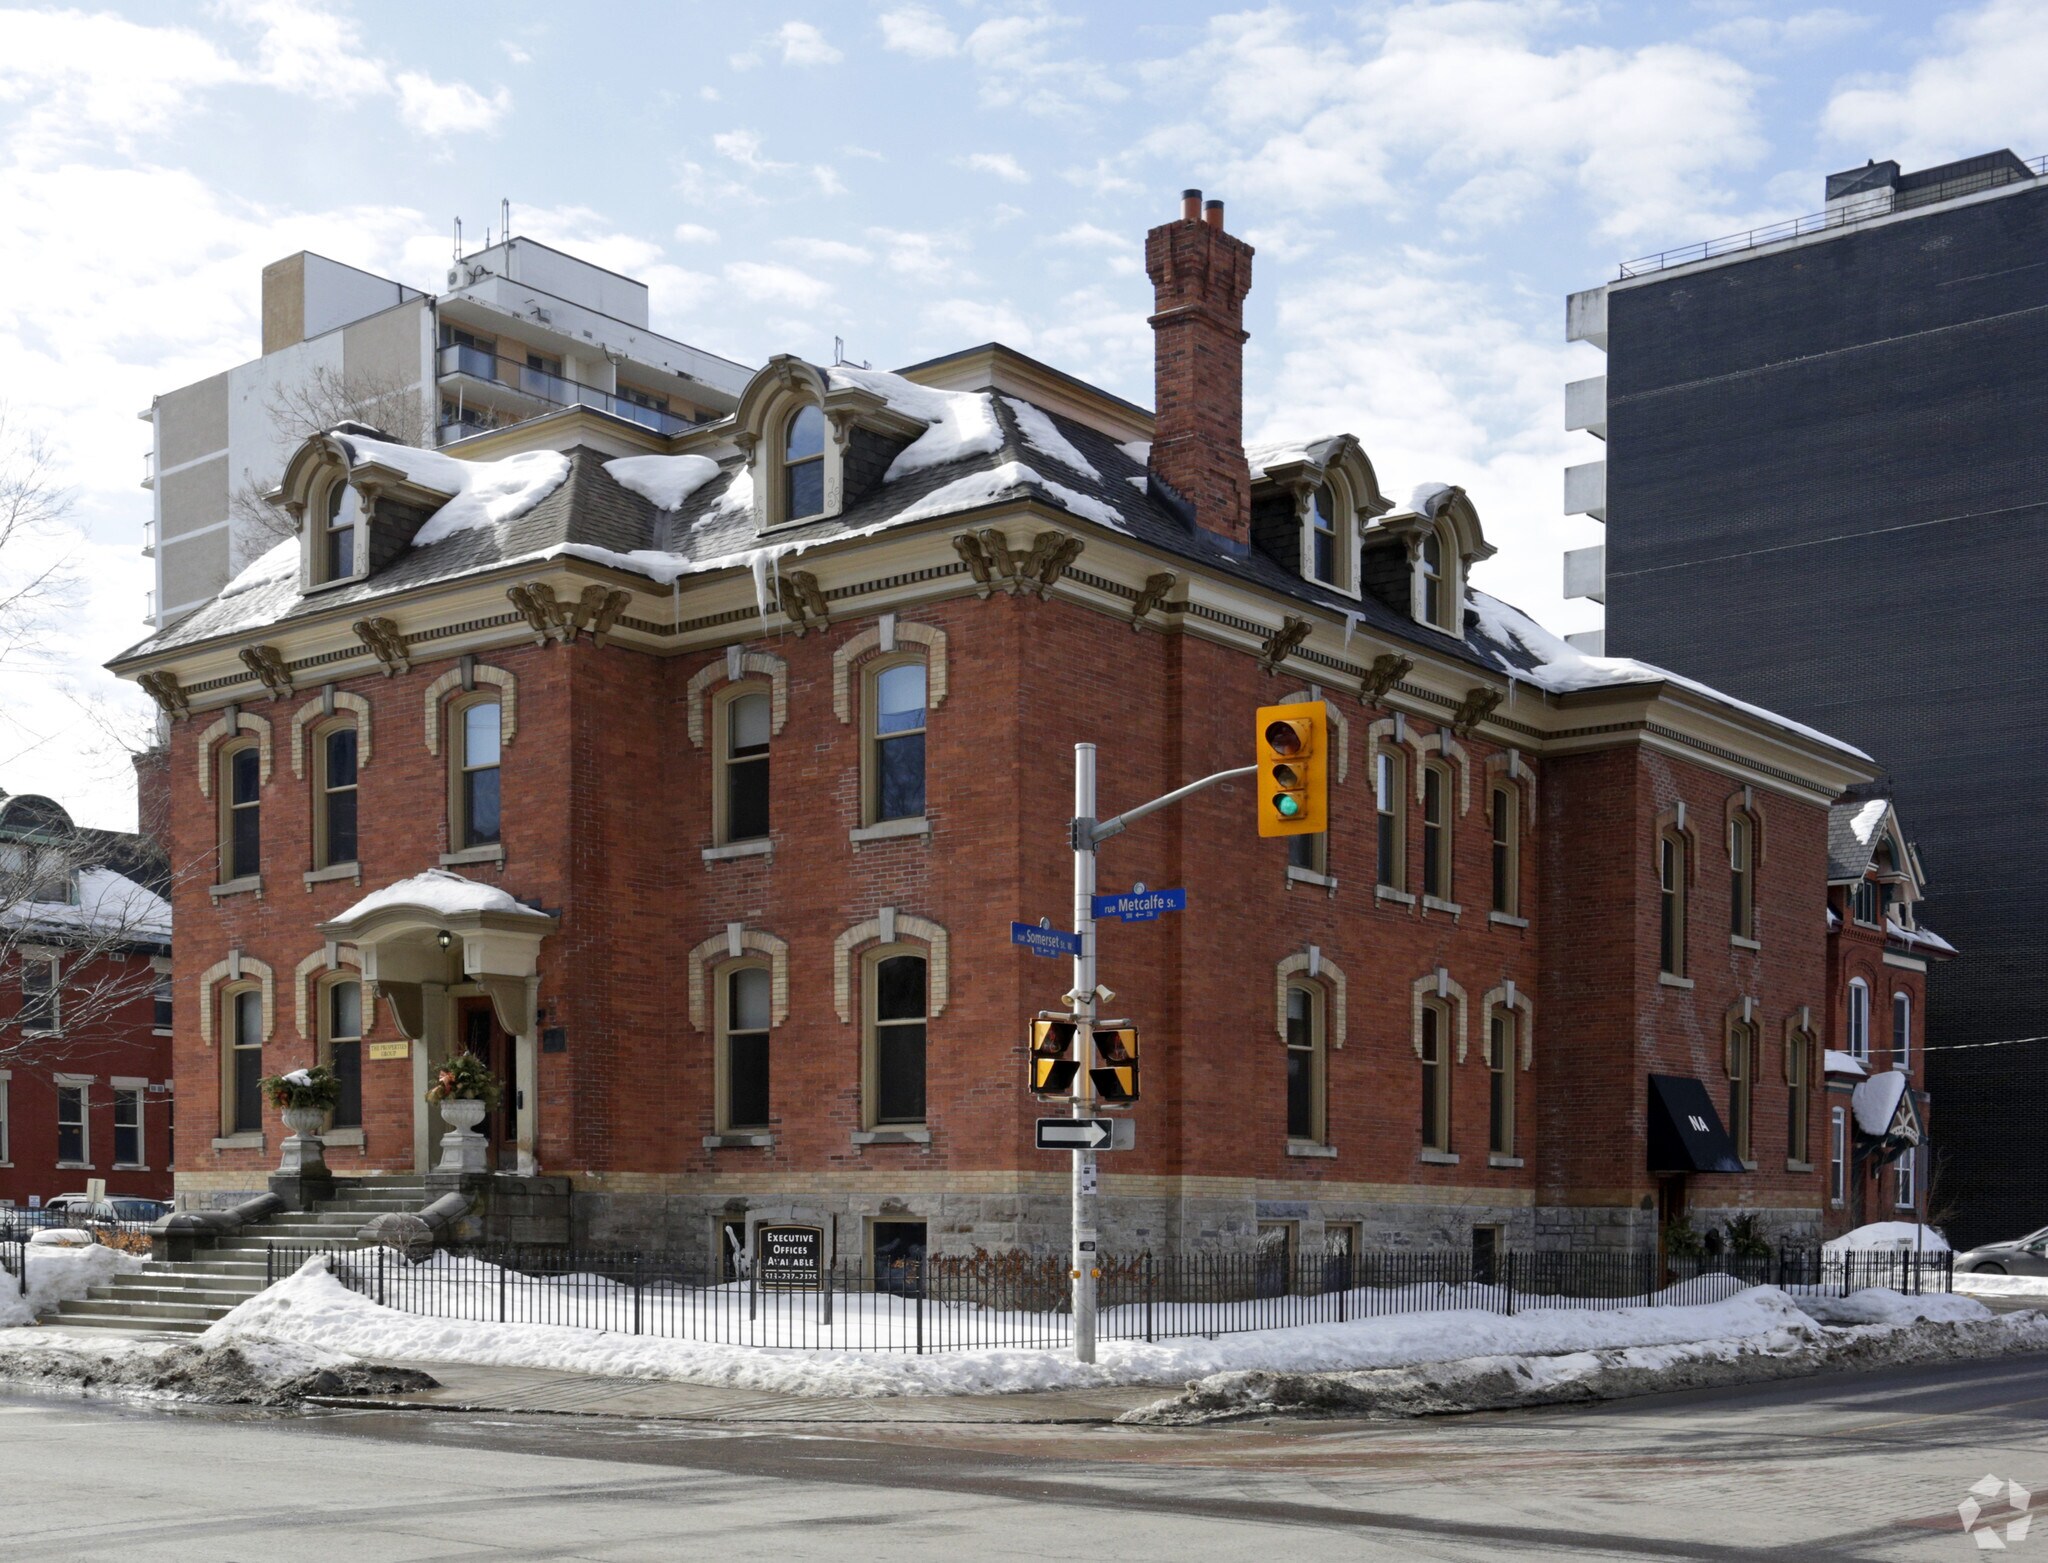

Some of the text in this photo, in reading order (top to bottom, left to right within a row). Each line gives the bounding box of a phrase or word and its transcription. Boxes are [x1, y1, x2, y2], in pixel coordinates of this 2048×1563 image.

[1104, 894, 1177, 914] rue Metcalfe St.
[1017, 933, 1026, 943] rue
[1026, 929, 1060, 948] Somerset
[1688, 1115, 1710, 1132] NA
[767, 1256, 814, 1267] AVAIABLE
